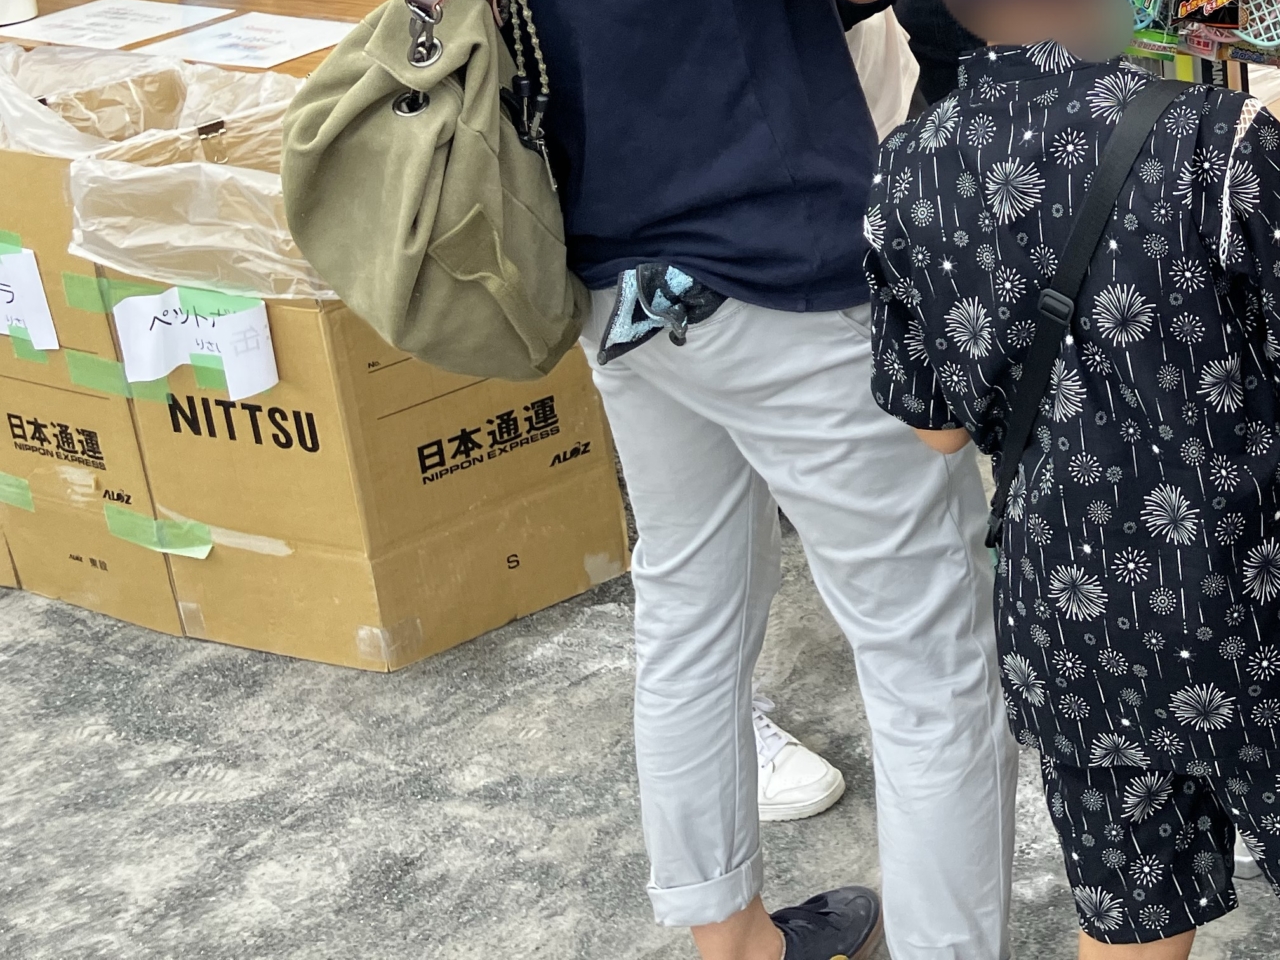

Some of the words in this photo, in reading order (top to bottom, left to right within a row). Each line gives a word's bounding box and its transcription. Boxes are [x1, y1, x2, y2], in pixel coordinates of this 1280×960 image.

[7, 413, 104, 461] 日本通運
[168, 393, 320, 453] NITTSU
[417, 395, 560, 474] 日本通運
[14, 441, 55, 458] NIPPON
[55, 451, 106, 471] EXPRESS
[422, 454, 484, 485] NIPPON
[487, 426, 560, 459] EXPRESS
[506, 554, 520, 570] S
